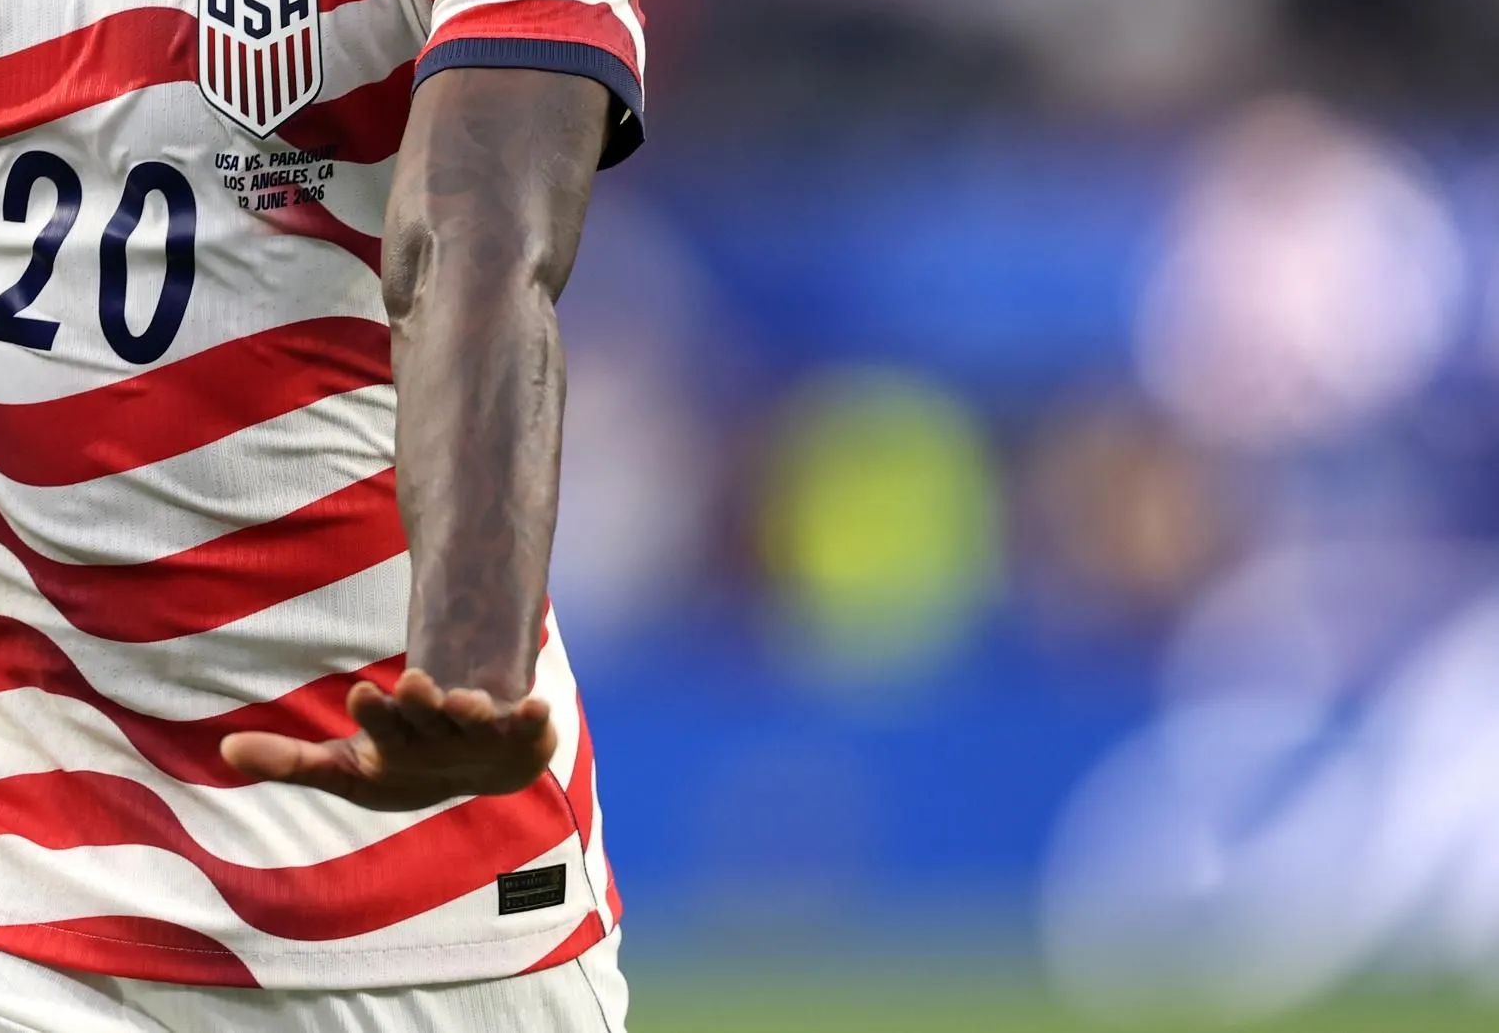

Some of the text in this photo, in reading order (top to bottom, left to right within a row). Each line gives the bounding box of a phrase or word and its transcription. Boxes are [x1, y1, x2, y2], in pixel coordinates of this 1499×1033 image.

[215, 153, 240, 171] USA
[245, 154, 264, 171] VS.
[224, 163, 334, 192] LOS ANGELES, CA
[238, 184, 325, 211] 12 JUNE 2026
